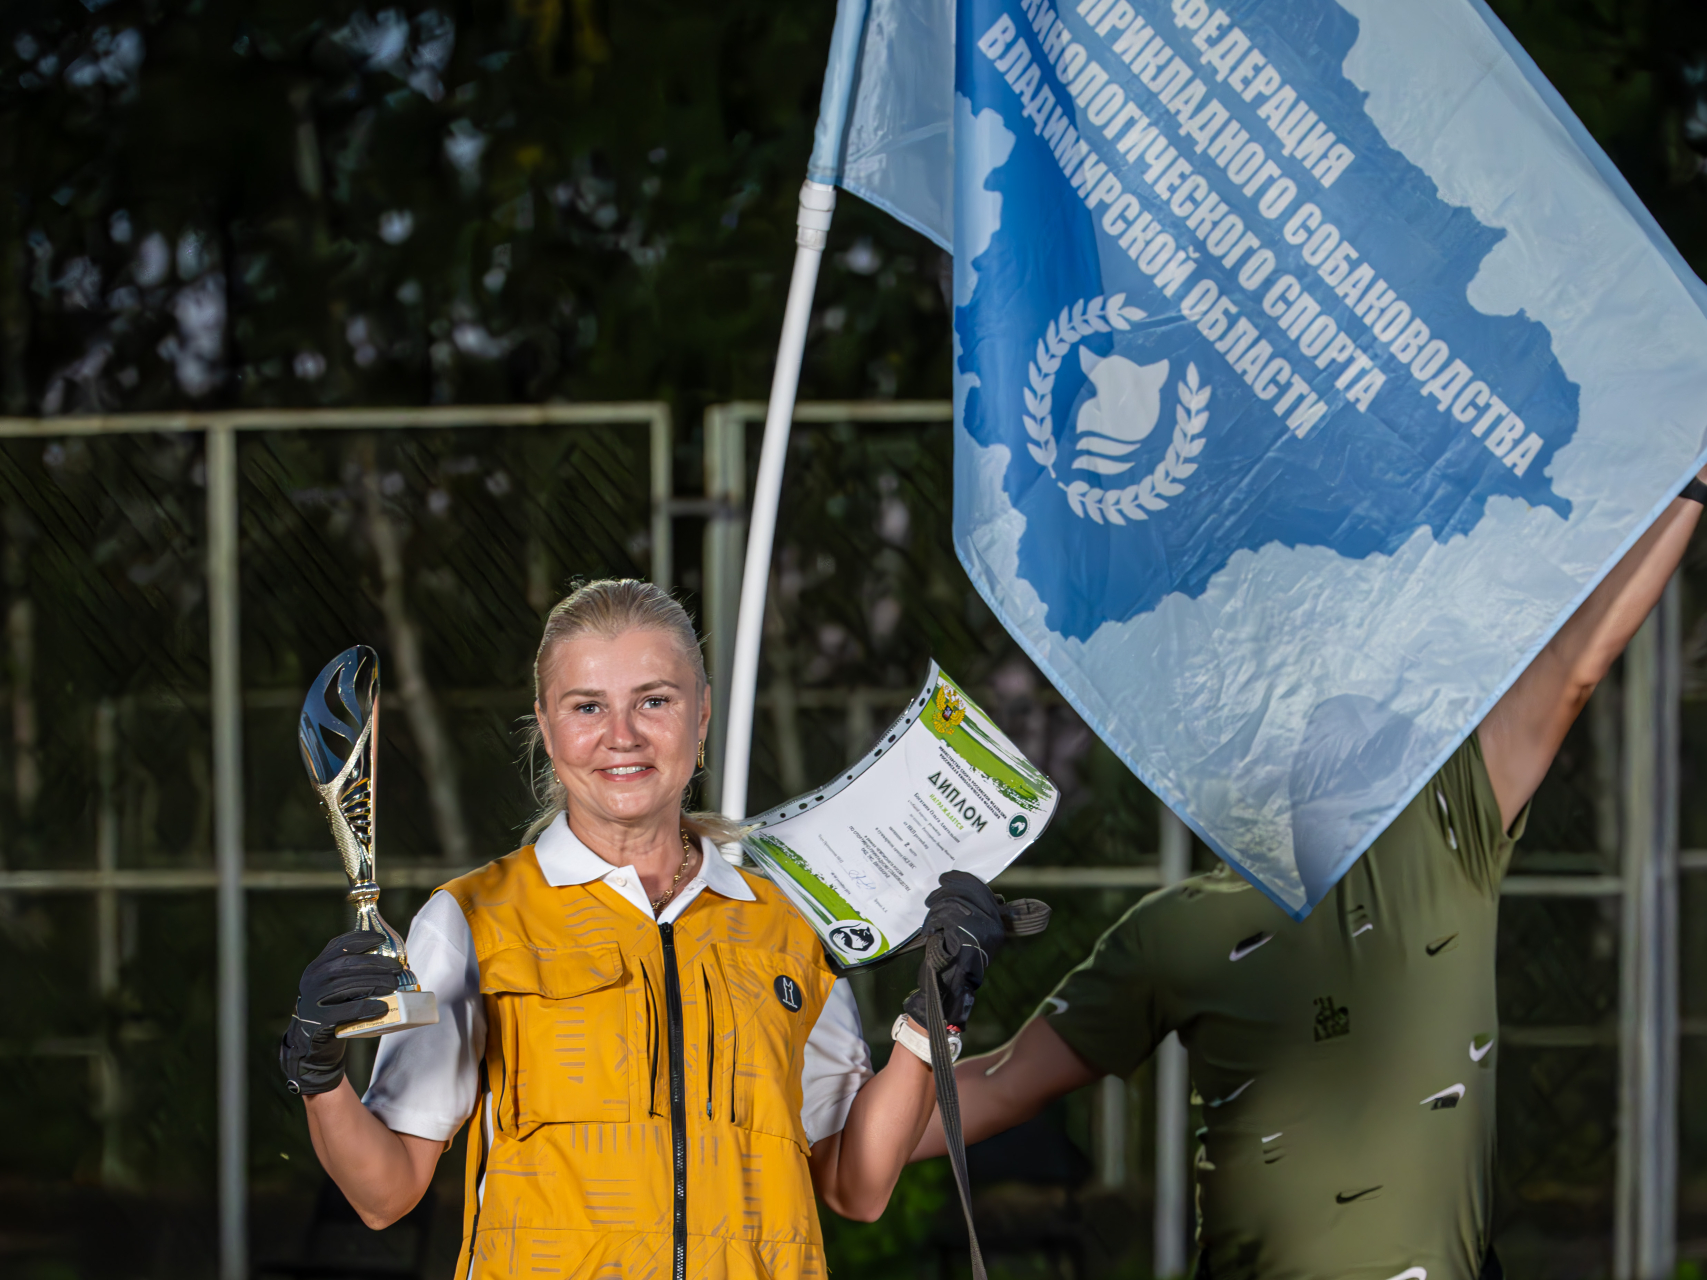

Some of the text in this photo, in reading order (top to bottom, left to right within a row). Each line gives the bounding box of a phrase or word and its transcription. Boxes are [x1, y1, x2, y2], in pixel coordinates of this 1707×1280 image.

[1171, 0, 1355, 189] ФЕДЕРАЦИЯ
[978, 13, 1328, 438] ВЛАДИМИРСКОЙ ОБЛАСТИ
[1263, 274, 1387, 413] СПОРТА
[1283, 202, 1543, 477] СОБАКОВОДСТВА
[927, 768, 988, 834] ДИПЛОМ
[929, 793, 964, 831] НАГРАЖДАЕТСЯ
